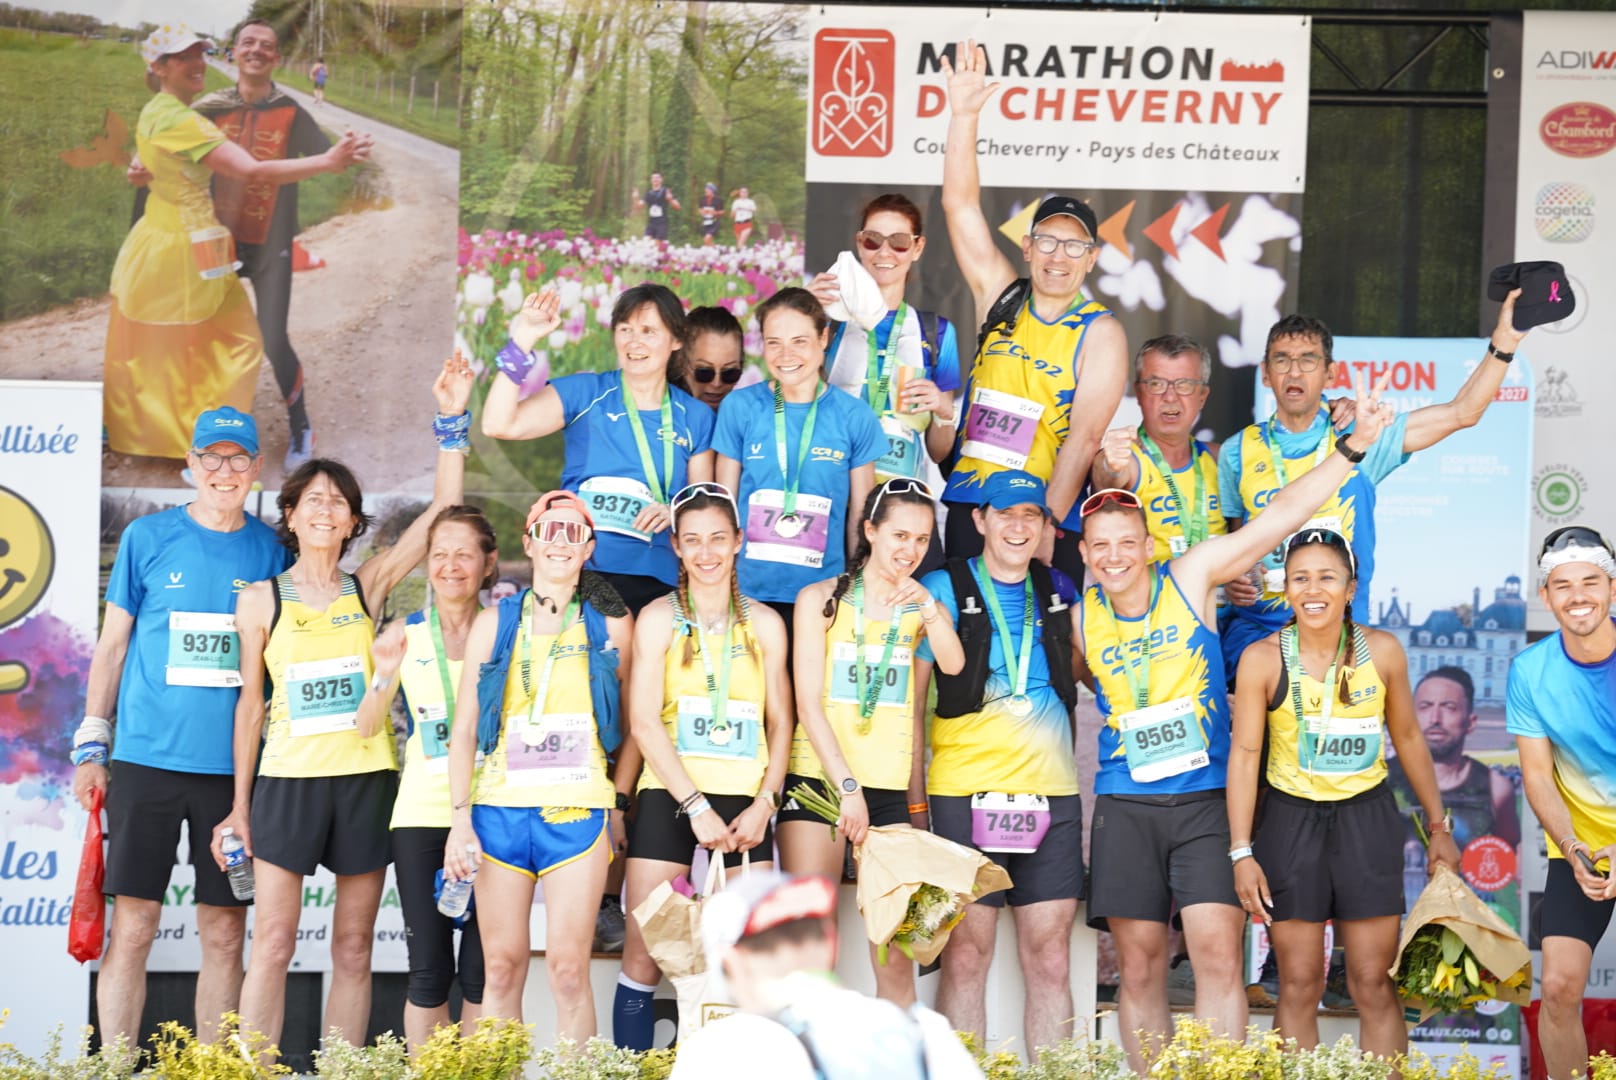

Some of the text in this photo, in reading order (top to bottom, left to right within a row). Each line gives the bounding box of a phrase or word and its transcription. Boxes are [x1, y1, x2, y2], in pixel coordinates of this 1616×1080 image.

[999, 86, 1283, 126] CHEVERNY
[1545, 121, 1616, 138] Chambord
[1089, 141, 1135, 163] Pays
[1142, 142, 1175, 159] des
[1183, 143, 1280, 161] Châteaux
[1034, 359, 1063, 378] 92
[975, 408, 1023, 436] 7547
[0, 423, 79, 454] llisée
[592, 494, 643, 517] 9373
[763, 509, 815, 533] 77
[183, 633, 231, 654] 9376
[1151, 624, 1179, 649] 92
[301, 677, 353, 702] 9375
[1135, 719, 1187, 750] 9563
[985, 812, 1038, 833] 7429
[0, 896, 74, 927] alité
